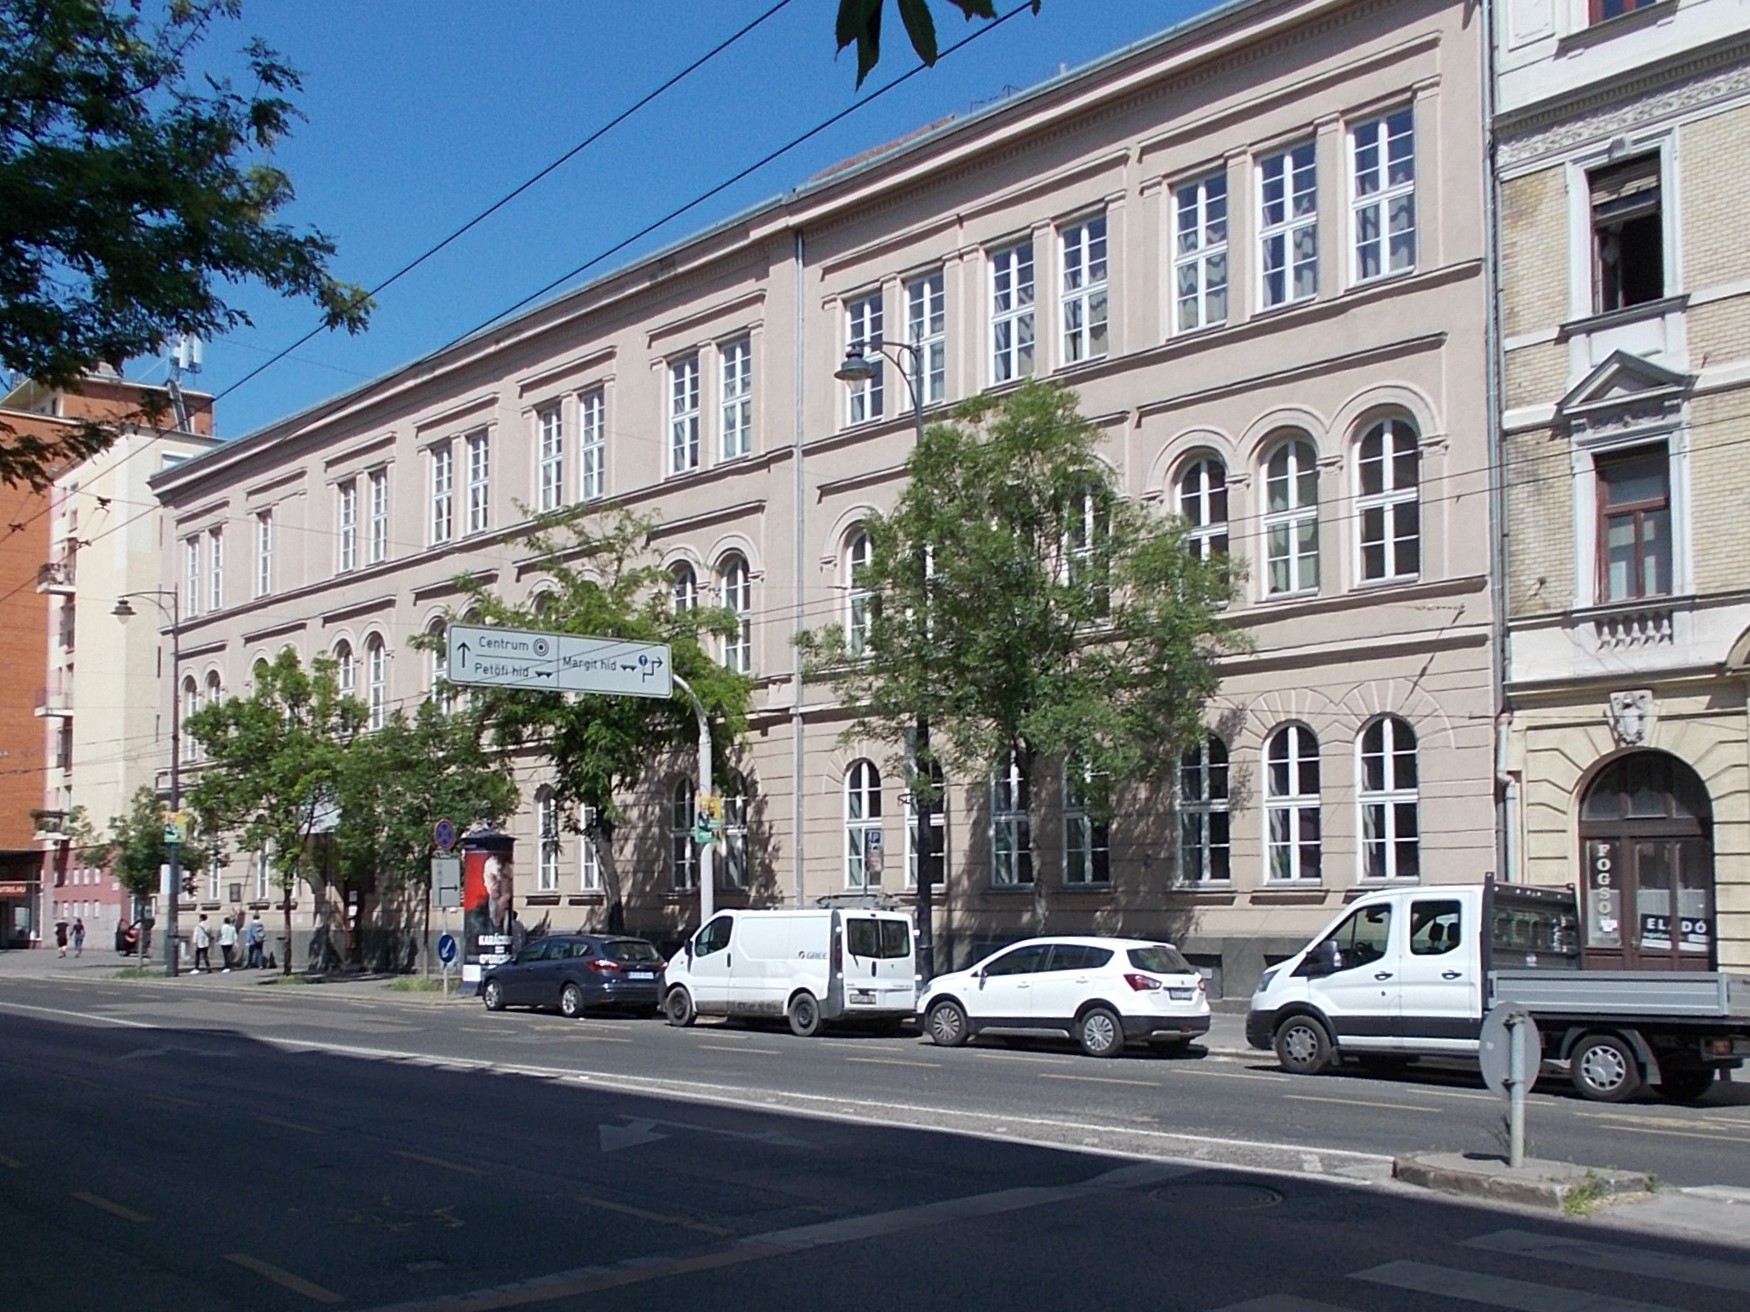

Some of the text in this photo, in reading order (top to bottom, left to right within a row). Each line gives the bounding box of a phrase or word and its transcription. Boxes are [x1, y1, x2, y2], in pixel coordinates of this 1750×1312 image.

[478, 636, 529, 651] Centrum
[562, 656, 598, 671] Margit
[1596, 843, 1612, 930] FOGSO
[1646, 917, 1707, 934] ELDÓ
[806, 951, 828, 960] GREE
